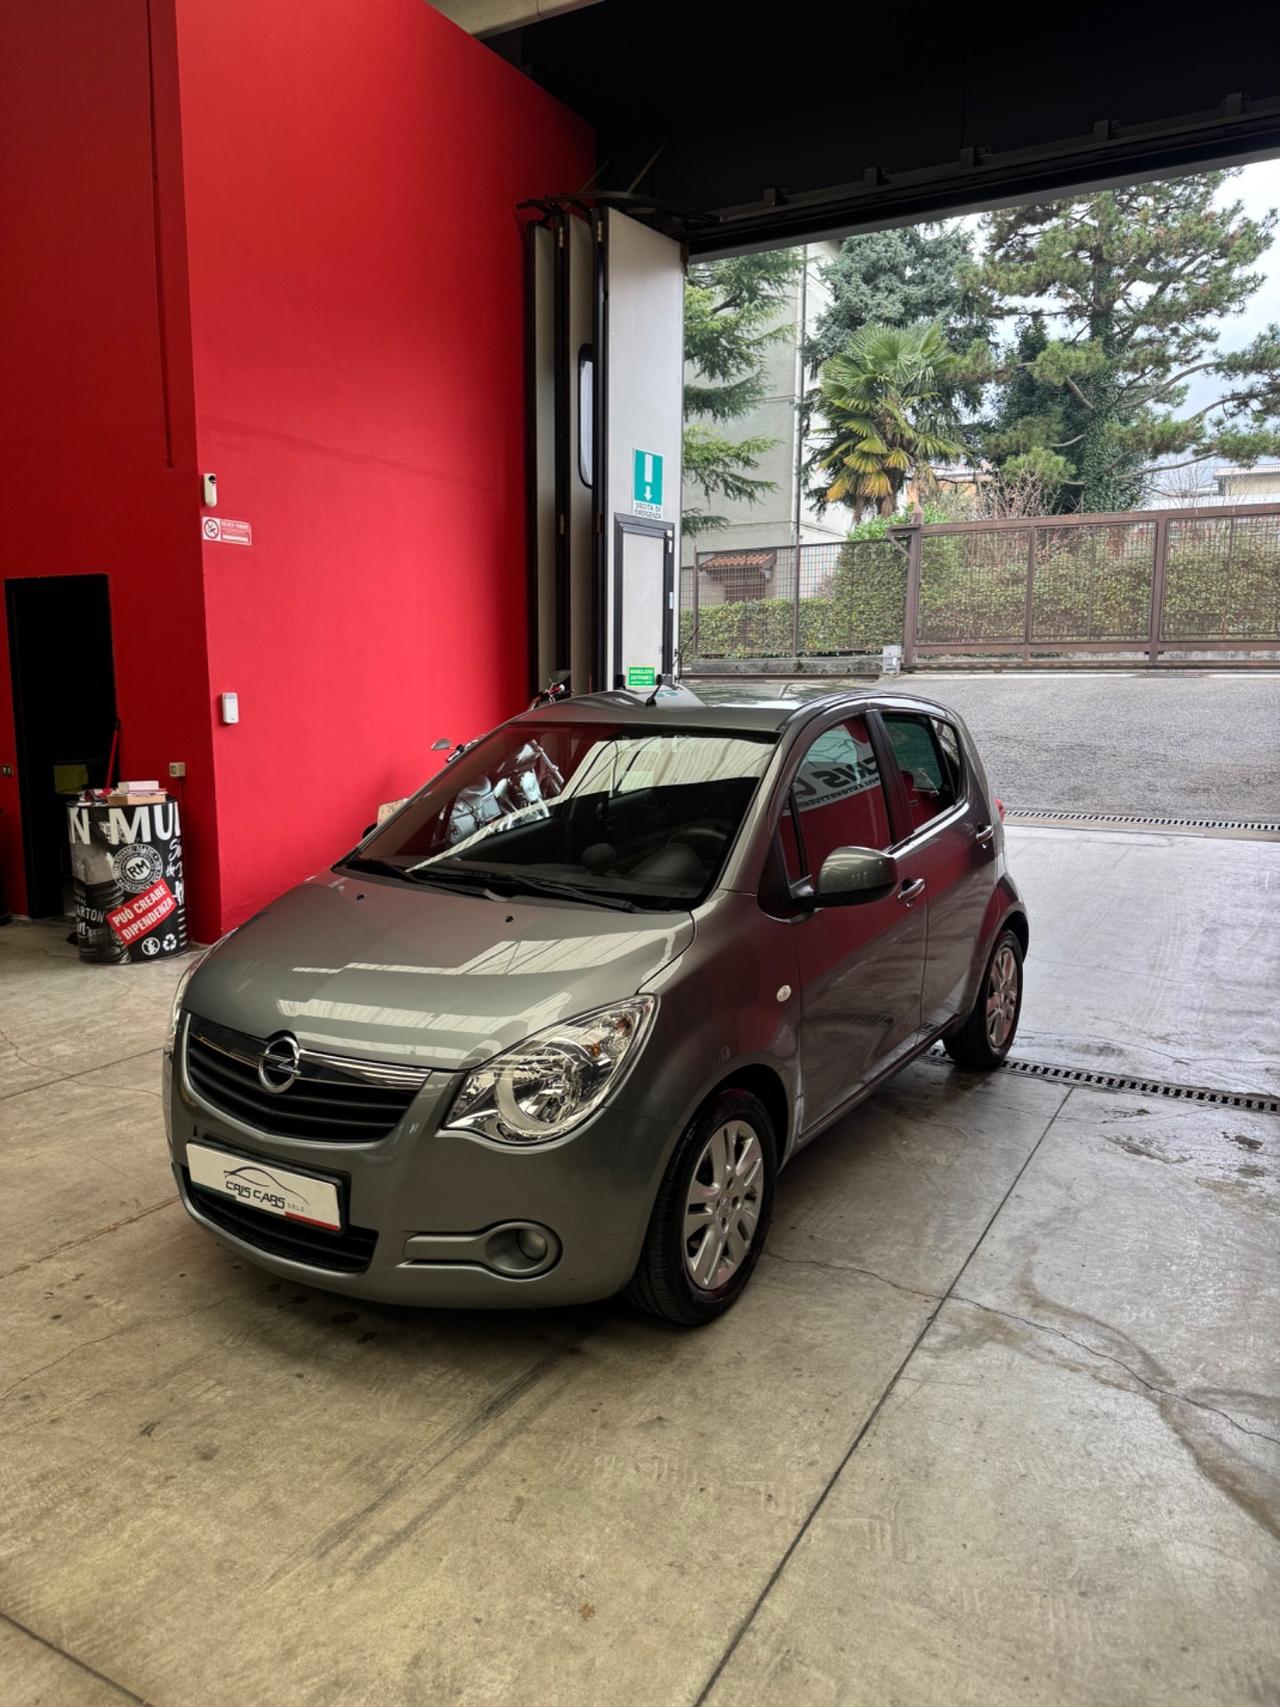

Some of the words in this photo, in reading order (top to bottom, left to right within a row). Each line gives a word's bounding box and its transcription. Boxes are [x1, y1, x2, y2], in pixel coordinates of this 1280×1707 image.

[127, 859, 150, 878] RM
[112, 907, 135, 927] PUÒ
[133, 885, 168, 914] CREARE
[122, 897, 174, 939] DIPENDENZA
[225, 1181, 252, 1199] CRIS
[252, 1189, 286, 1210] CARS
